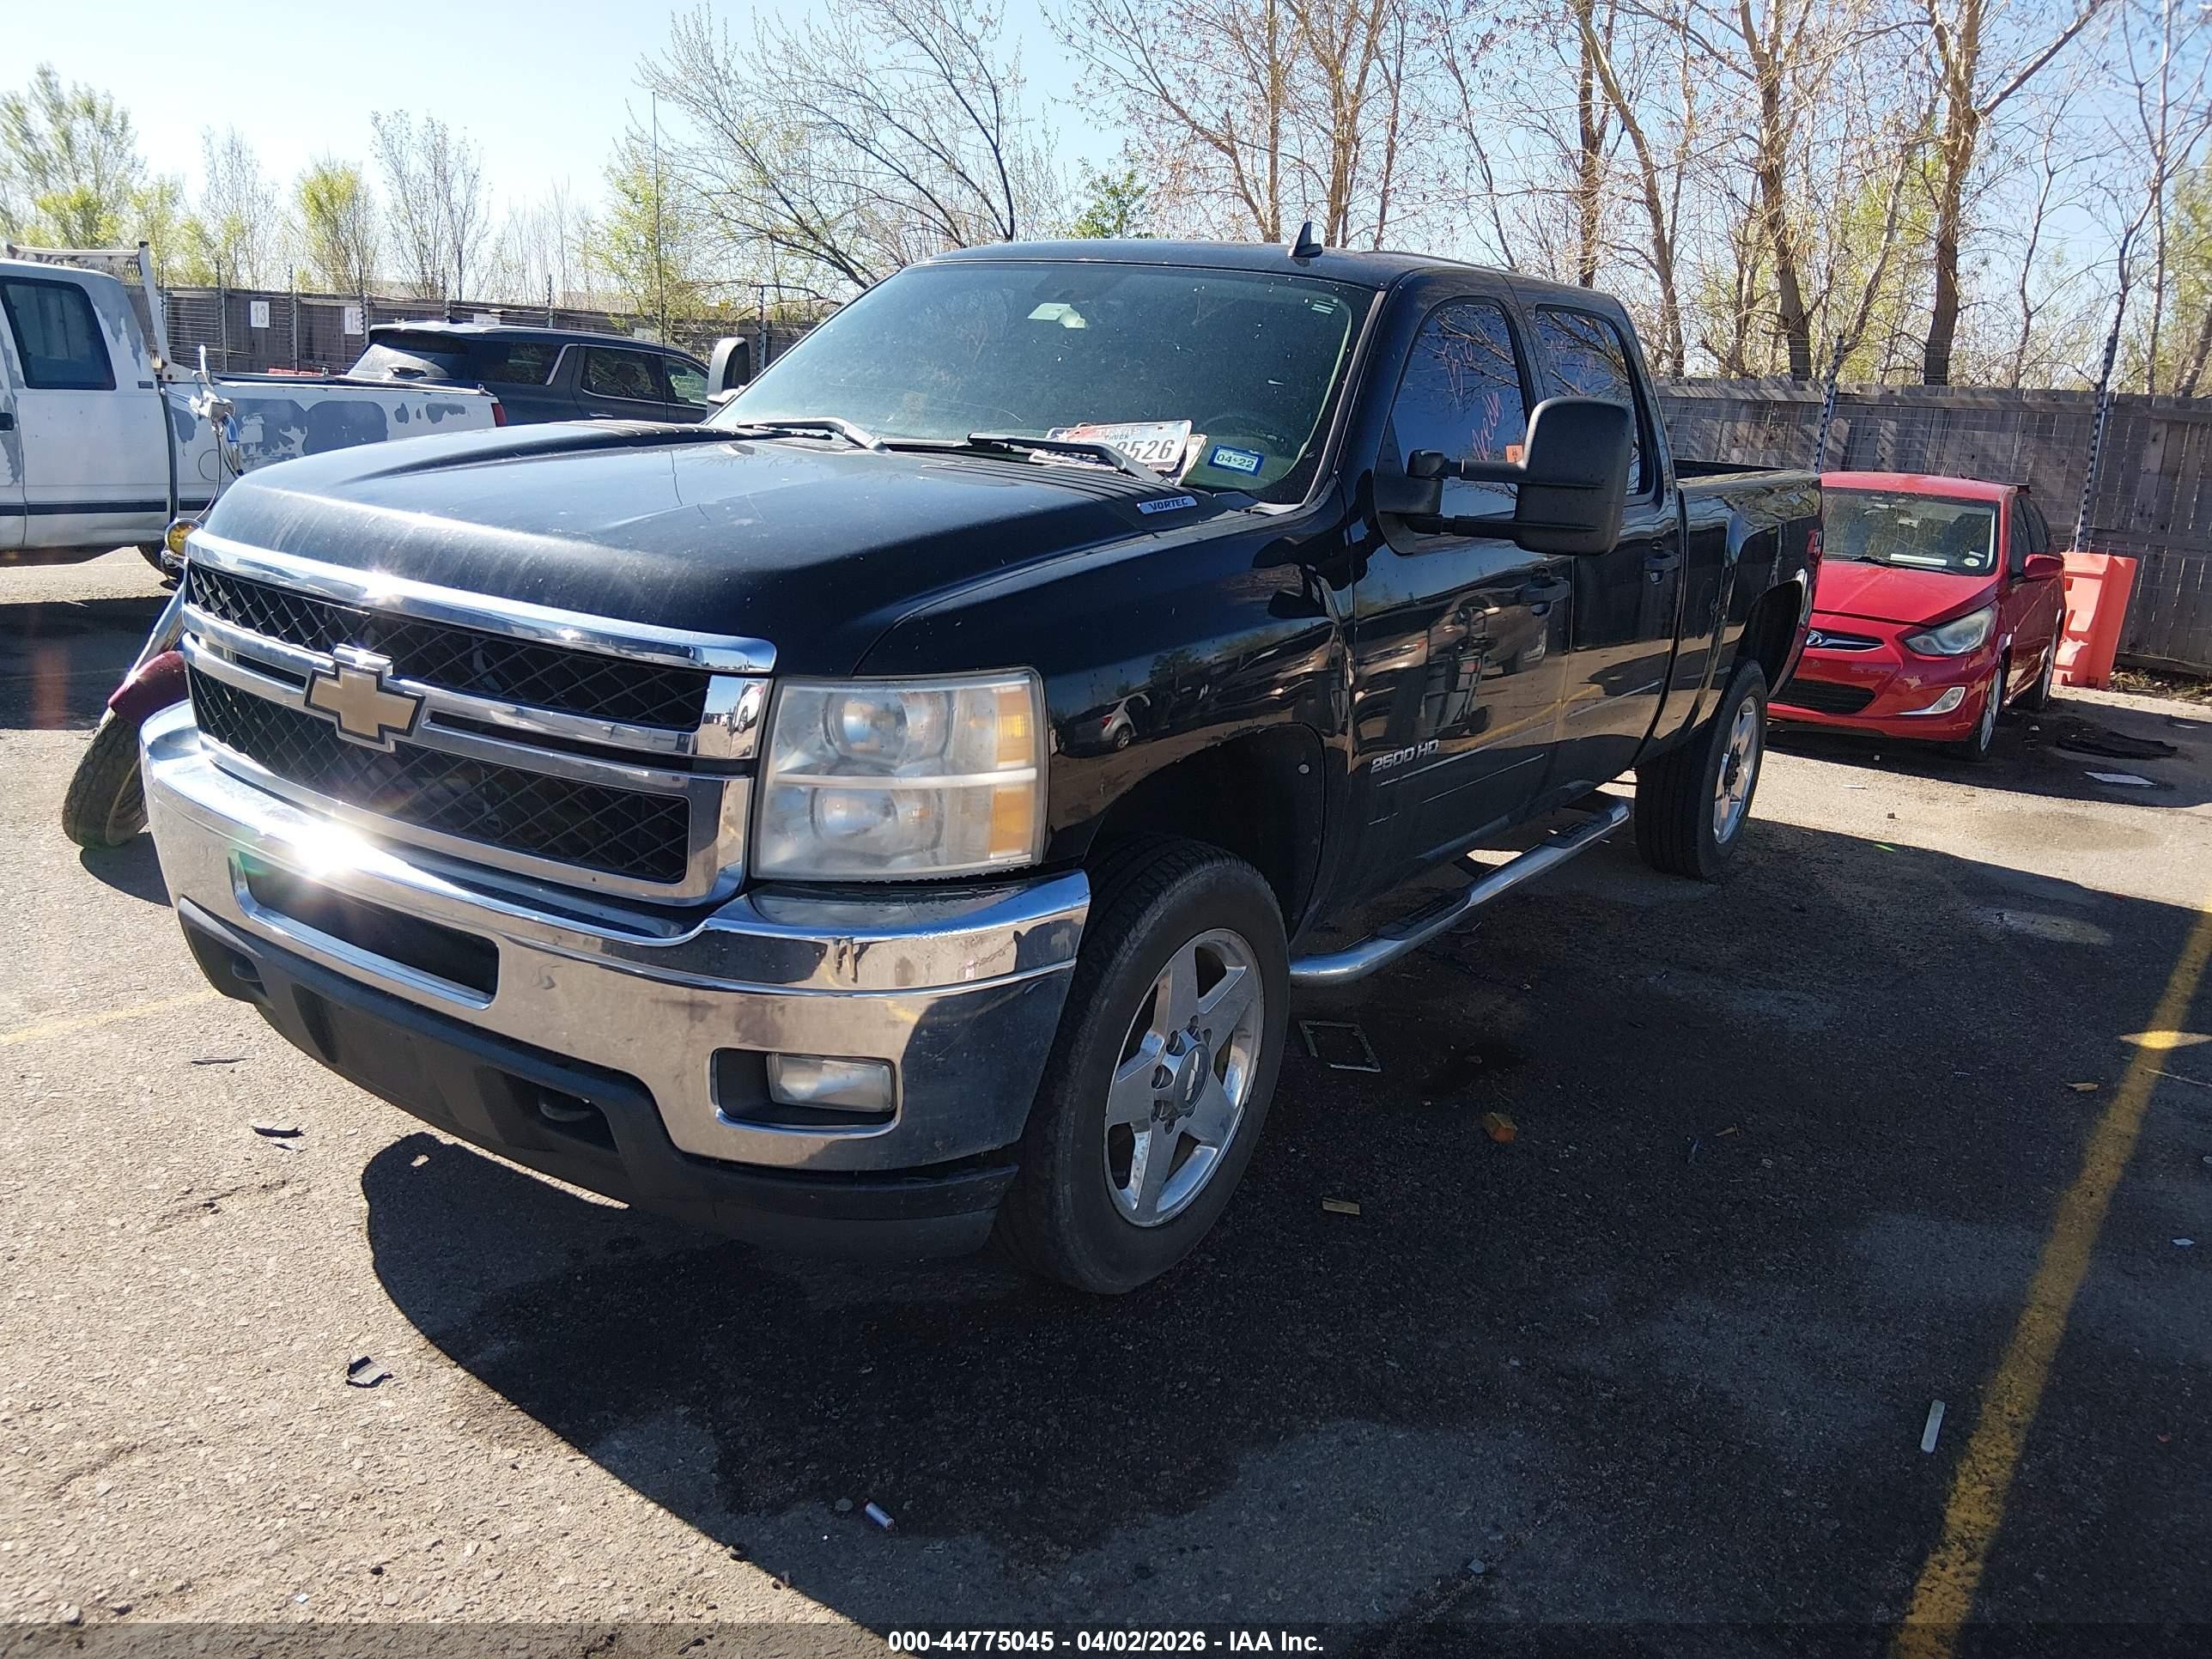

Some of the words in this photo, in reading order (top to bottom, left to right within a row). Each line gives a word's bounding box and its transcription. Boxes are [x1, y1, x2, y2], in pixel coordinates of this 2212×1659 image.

[253, 306, 266, 324] 13
[1097, 427, 1141, 436] TEXAS
[1148, 498, 1188, 510] VORTEC
[1370, 746, 1415, 774] 2500
[1416, 738, 1439, 758] HD
